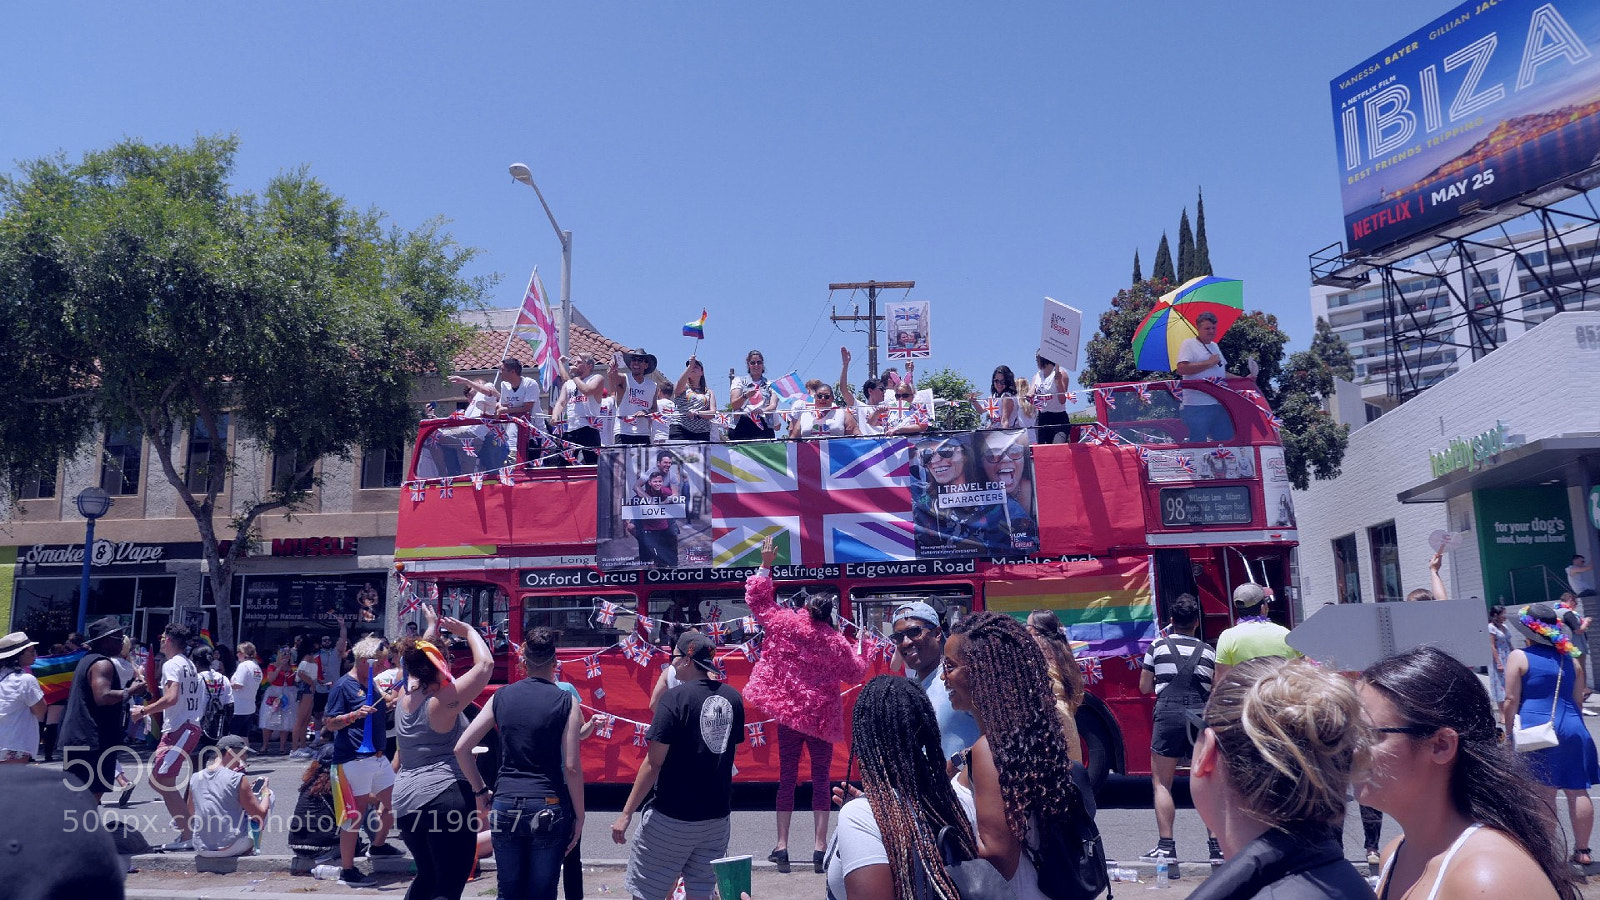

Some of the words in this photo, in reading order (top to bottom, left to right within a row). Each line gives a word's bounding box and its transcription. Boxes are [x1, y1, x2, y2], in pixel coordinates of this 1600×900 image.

[1339, 63, 1381, 90] VANESSA
[1384, 41, 1419, 65] BAYER
[1429, 12, 1471, 40] GILLIAN
[1341, 3, 1593, 171] IBIZA
[1348, 85, 1378, 103] NETFLIX
[1379, 74, 1397, 88] FILM
[1348, 168, 1371, 185] BEST
[1375, 145, 1422, 172] FRIENDS
[1427, 116, 1485, 148] TRIPPING
[1353, 200, 1412, 241] NETFLIX
[1431, 179, 1468, 206] MAY
[1472, 168, 1495, 190] 25
[944, 483, 983, 493] TRAVEL
[986, 481, 1006, 490] FOR
[626, 496, 661, 505] TRAVEL
[668, 495, 686, 504] FOR
[942, 492, 1003, 505] CHARACTERS
[641, 508, 666, 516] LOVE
[1166, 497, 1186, 521] 98
[1494, 521, 1508, 532] for
[1509, 523, 1530, 534] your
[1531, 517, 1565, 534] dog's
[272, 536, 358, 557] MUSCLE
[1515, 534, 1533, 544] body
[25, 544, 84, 563] Smoke
[116, 541, 163, 564] Vape
[560, 556, 590, 565] Long
[846, 562, 926, 576] Edgeware
[933, 560, 975, 572] Road
[526, 572, 581, 586] Oxford
[587, 571, 637, 584] Circus
[647, 567, 703, 582] Oxford
[710, 567, 760, 579] Street
[773, 565, 840, 578] Selfridges
[245, 613, 268, 621] Making
